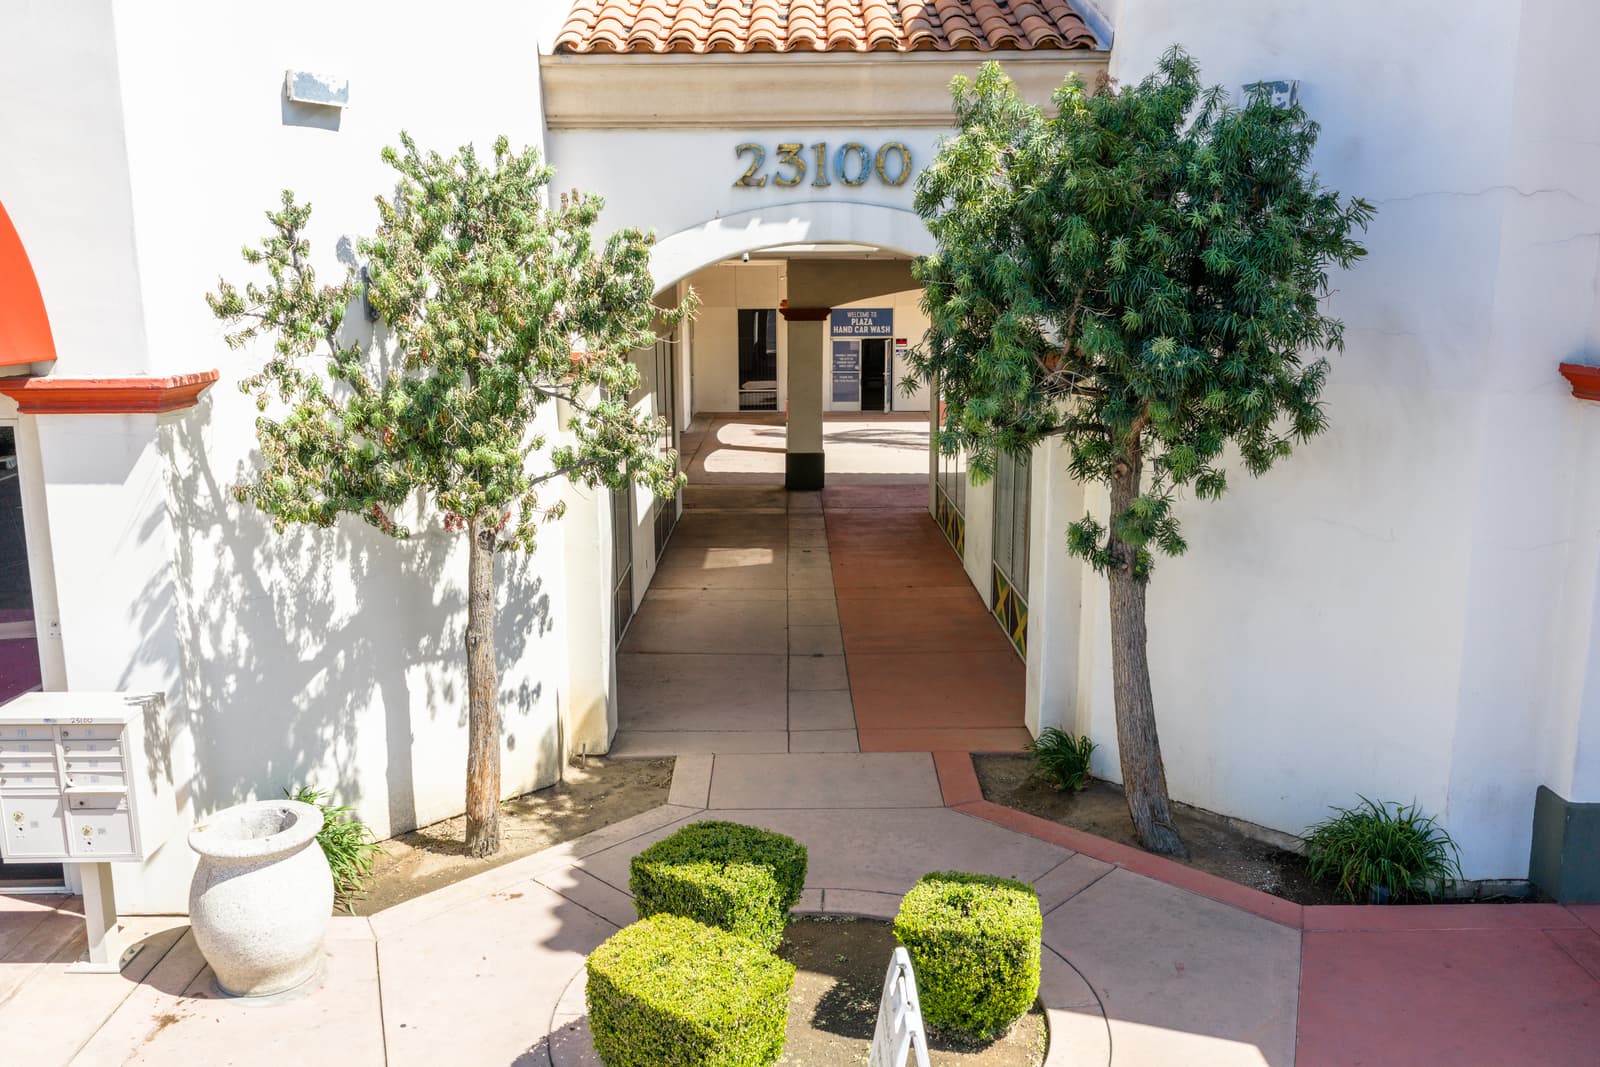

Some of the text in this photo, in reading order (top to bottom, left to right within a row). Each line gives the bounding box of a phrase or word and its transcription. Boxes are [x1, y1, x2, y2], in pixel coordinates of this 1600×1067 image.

[733, 141, 912, 187] 23100
[833, 325, 890, 333] HAND CAR WASH
